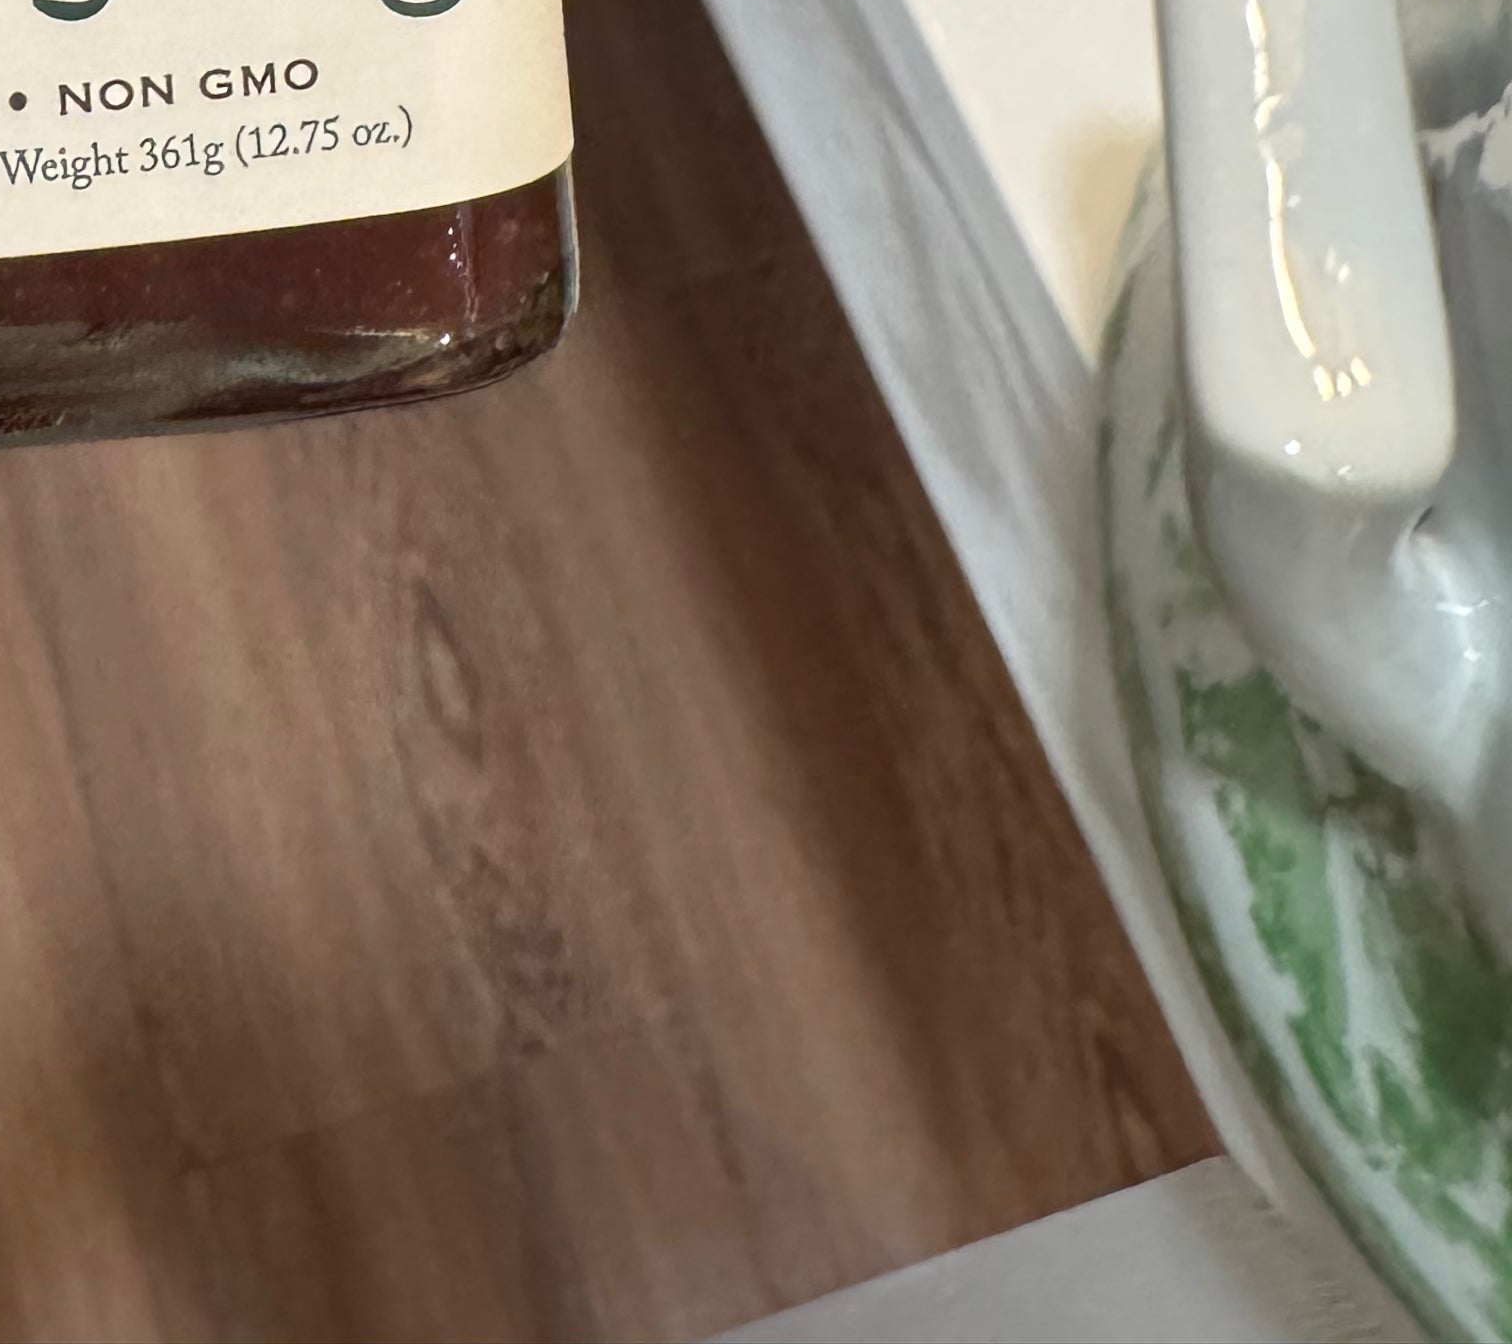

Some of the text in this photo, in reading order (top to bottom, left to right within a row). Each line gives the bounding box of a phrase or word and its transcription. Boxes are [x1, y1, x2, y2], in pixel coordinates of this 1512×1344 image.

[58, 74, 174, 116] NON
[199, 59, 318, 100] GMO
[140, 133, 224, 176] 361g
[236, 115, 339, 167] (12.75
[352, 105, 412, 148] oz.)
